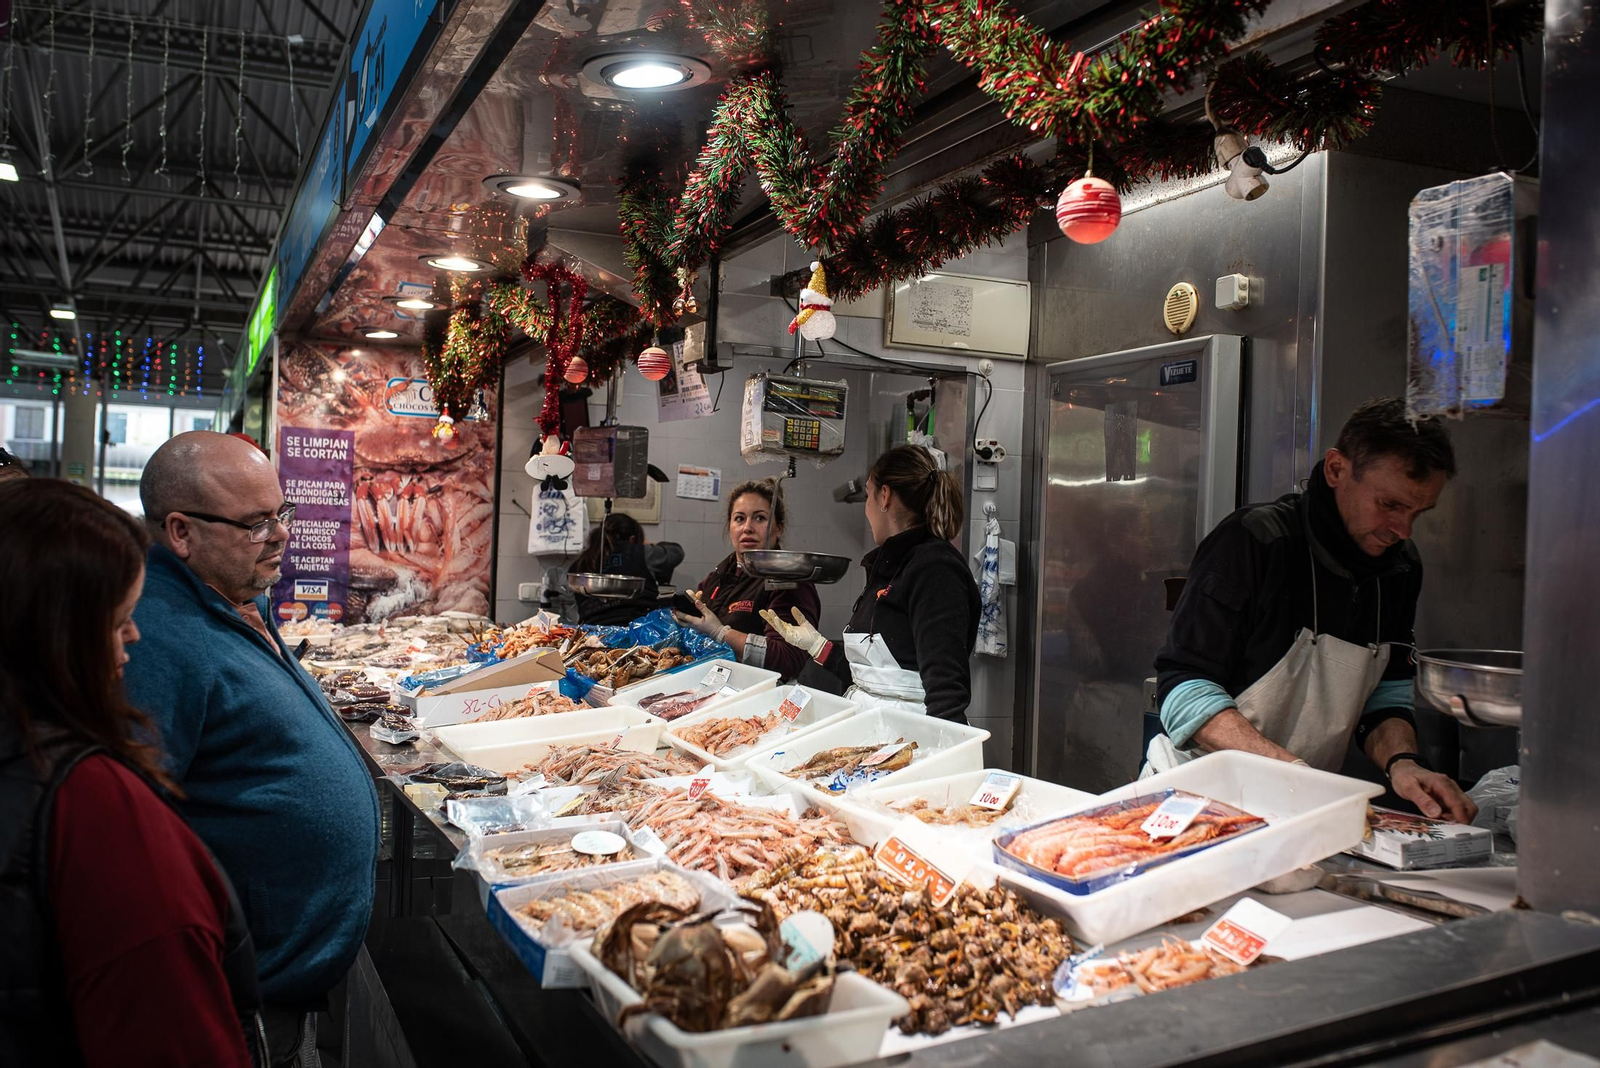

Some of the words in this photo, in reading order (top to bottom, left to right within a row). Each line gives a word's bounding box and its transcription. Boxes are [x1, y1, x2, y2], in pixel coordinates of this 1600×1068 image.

[1164, 362, 1194, 382] VIZUETE
[394, 402, 428, 411] CHOCOS
[286, 436, 300, 446] SE
[302, 437, 348, 450] LIMPIAN
[287, 446, 301, 457] SE
[303, 448, 347, 460] CORTAN
[286, 480, 296, 488] SE
[298, 480, 322, 488] PICAN
[324, 481, 346, 490] PARA
[292, 520, 340, 529] SPECIALIDAD
[301, 535, 332, 543] CHOCOS
[301, 556, 334, 564] ACEPTAN
[295, 564, 330, 572] TARJETAS
